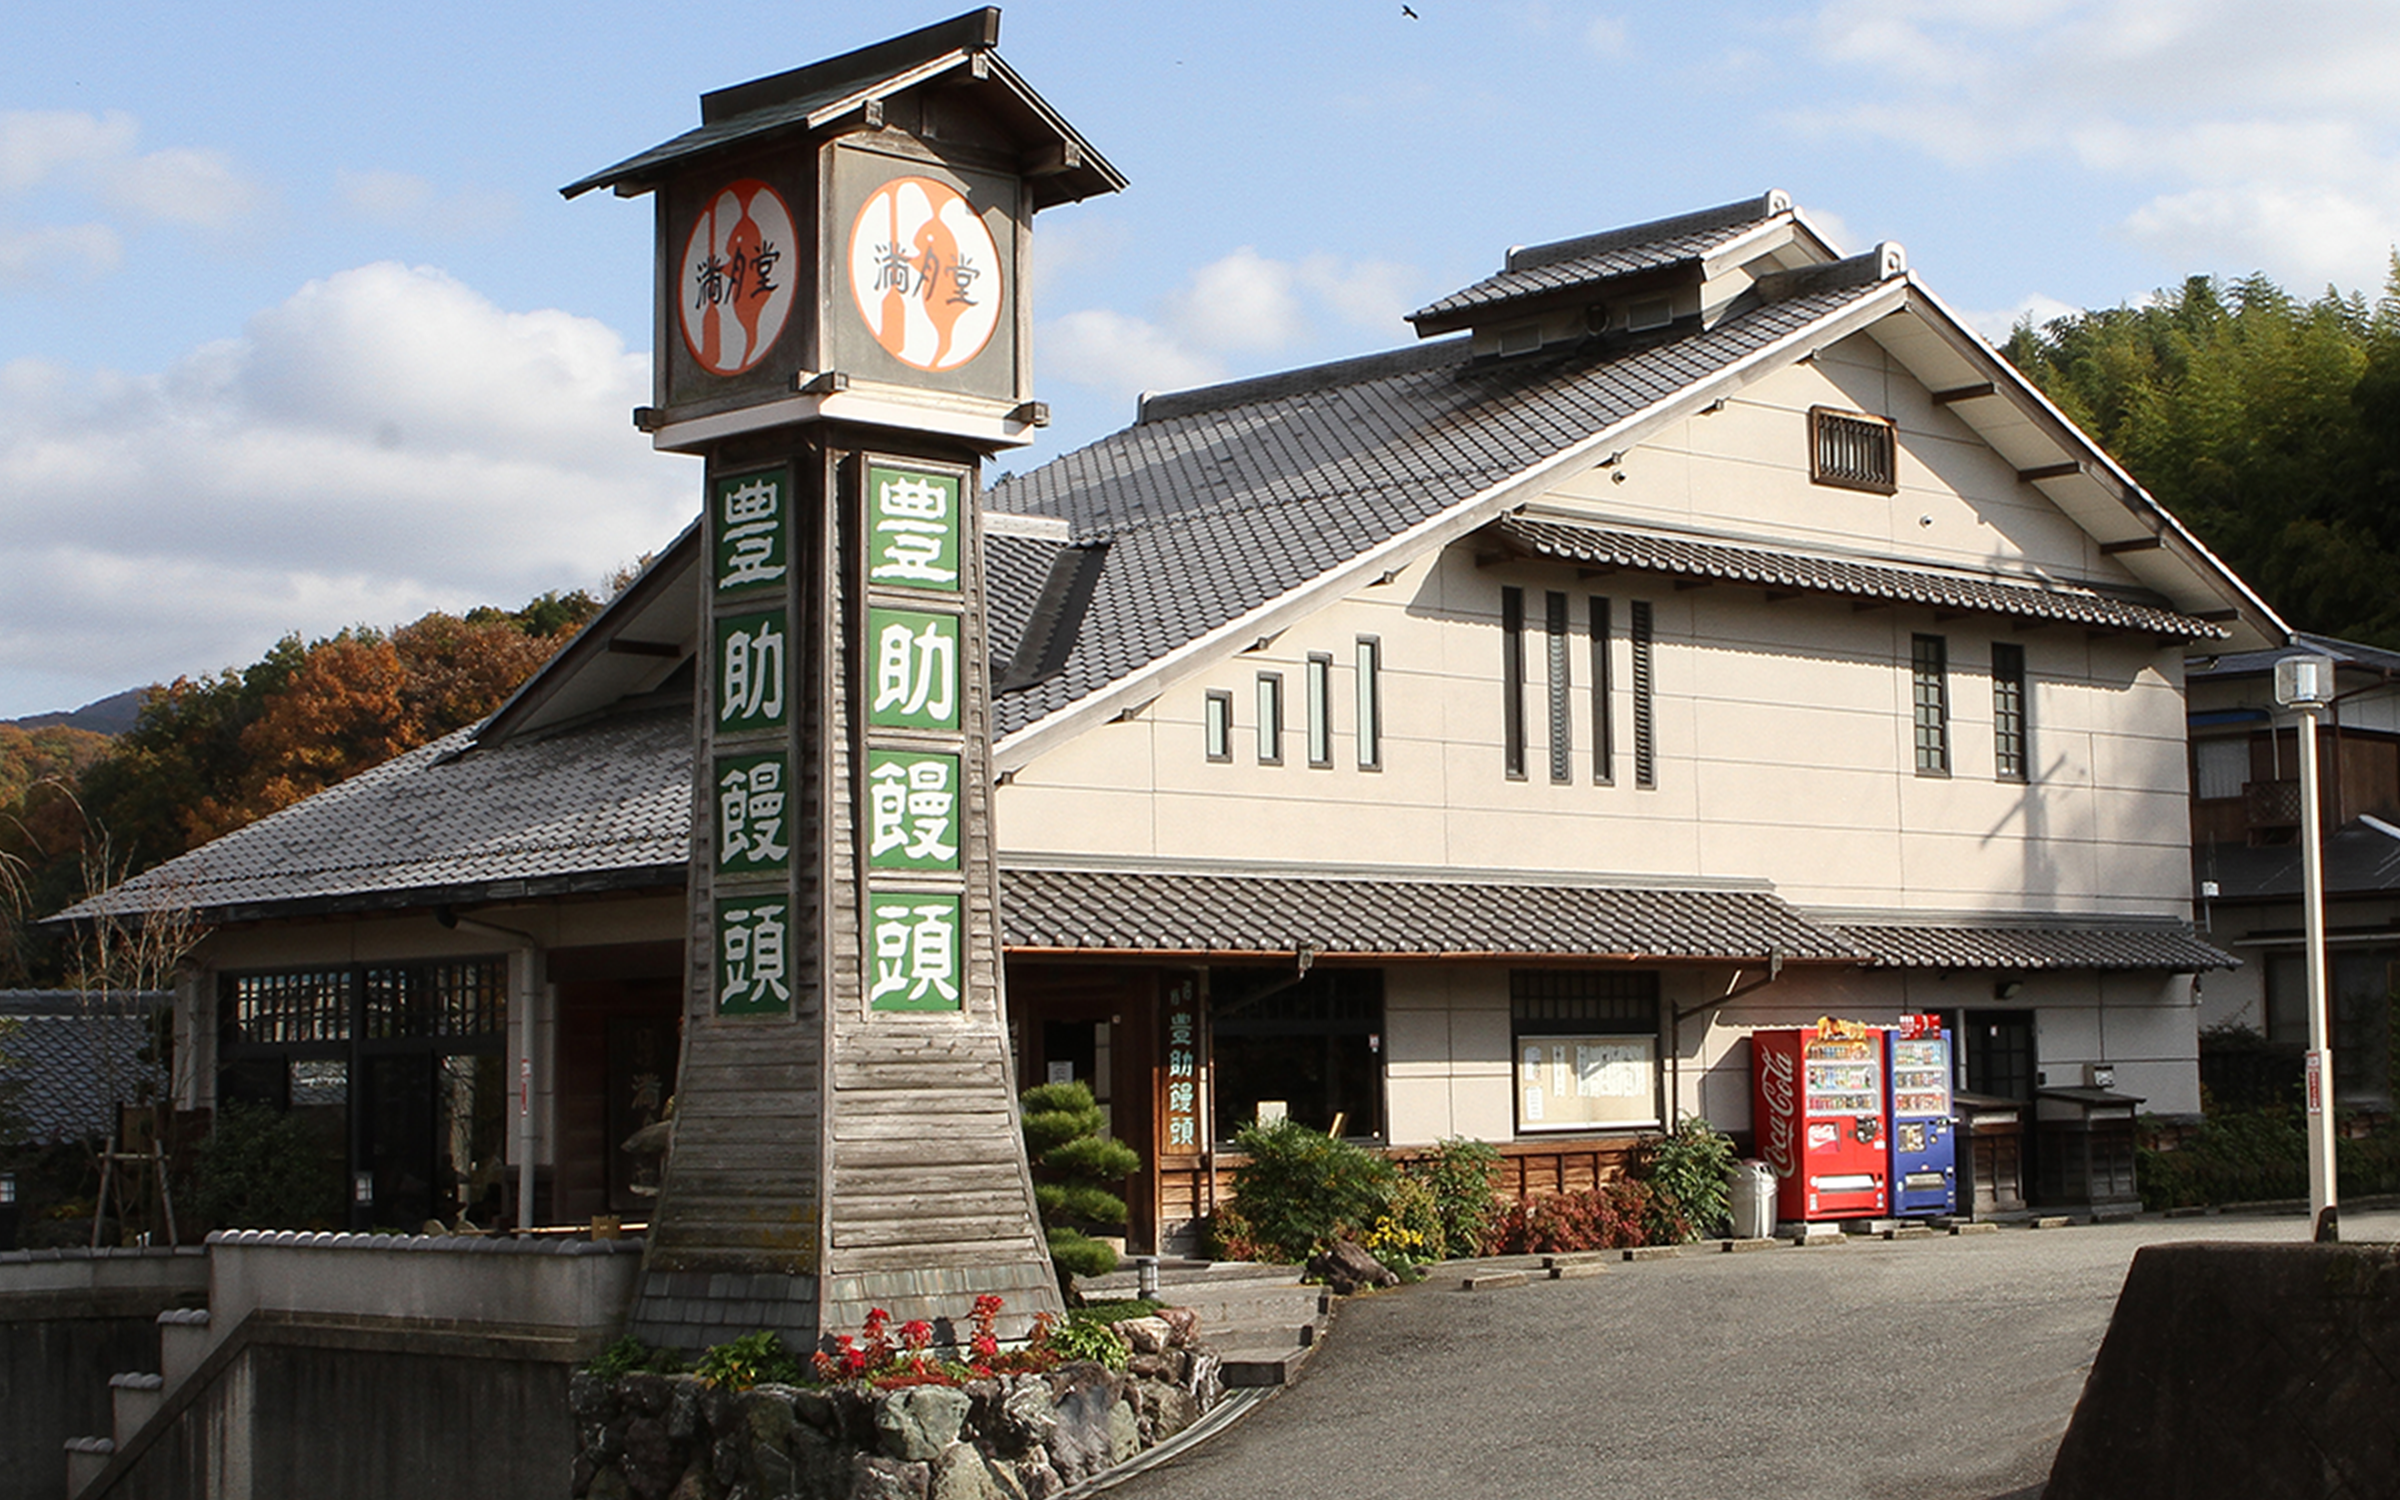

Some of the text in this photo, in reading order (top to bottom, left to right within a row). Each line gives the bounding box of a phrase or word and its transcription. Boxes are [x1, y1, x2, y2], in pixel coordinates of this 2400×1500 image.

[695, 239, 780, 309] 満月堂
[873, 240, 980, 307] 満月堂
